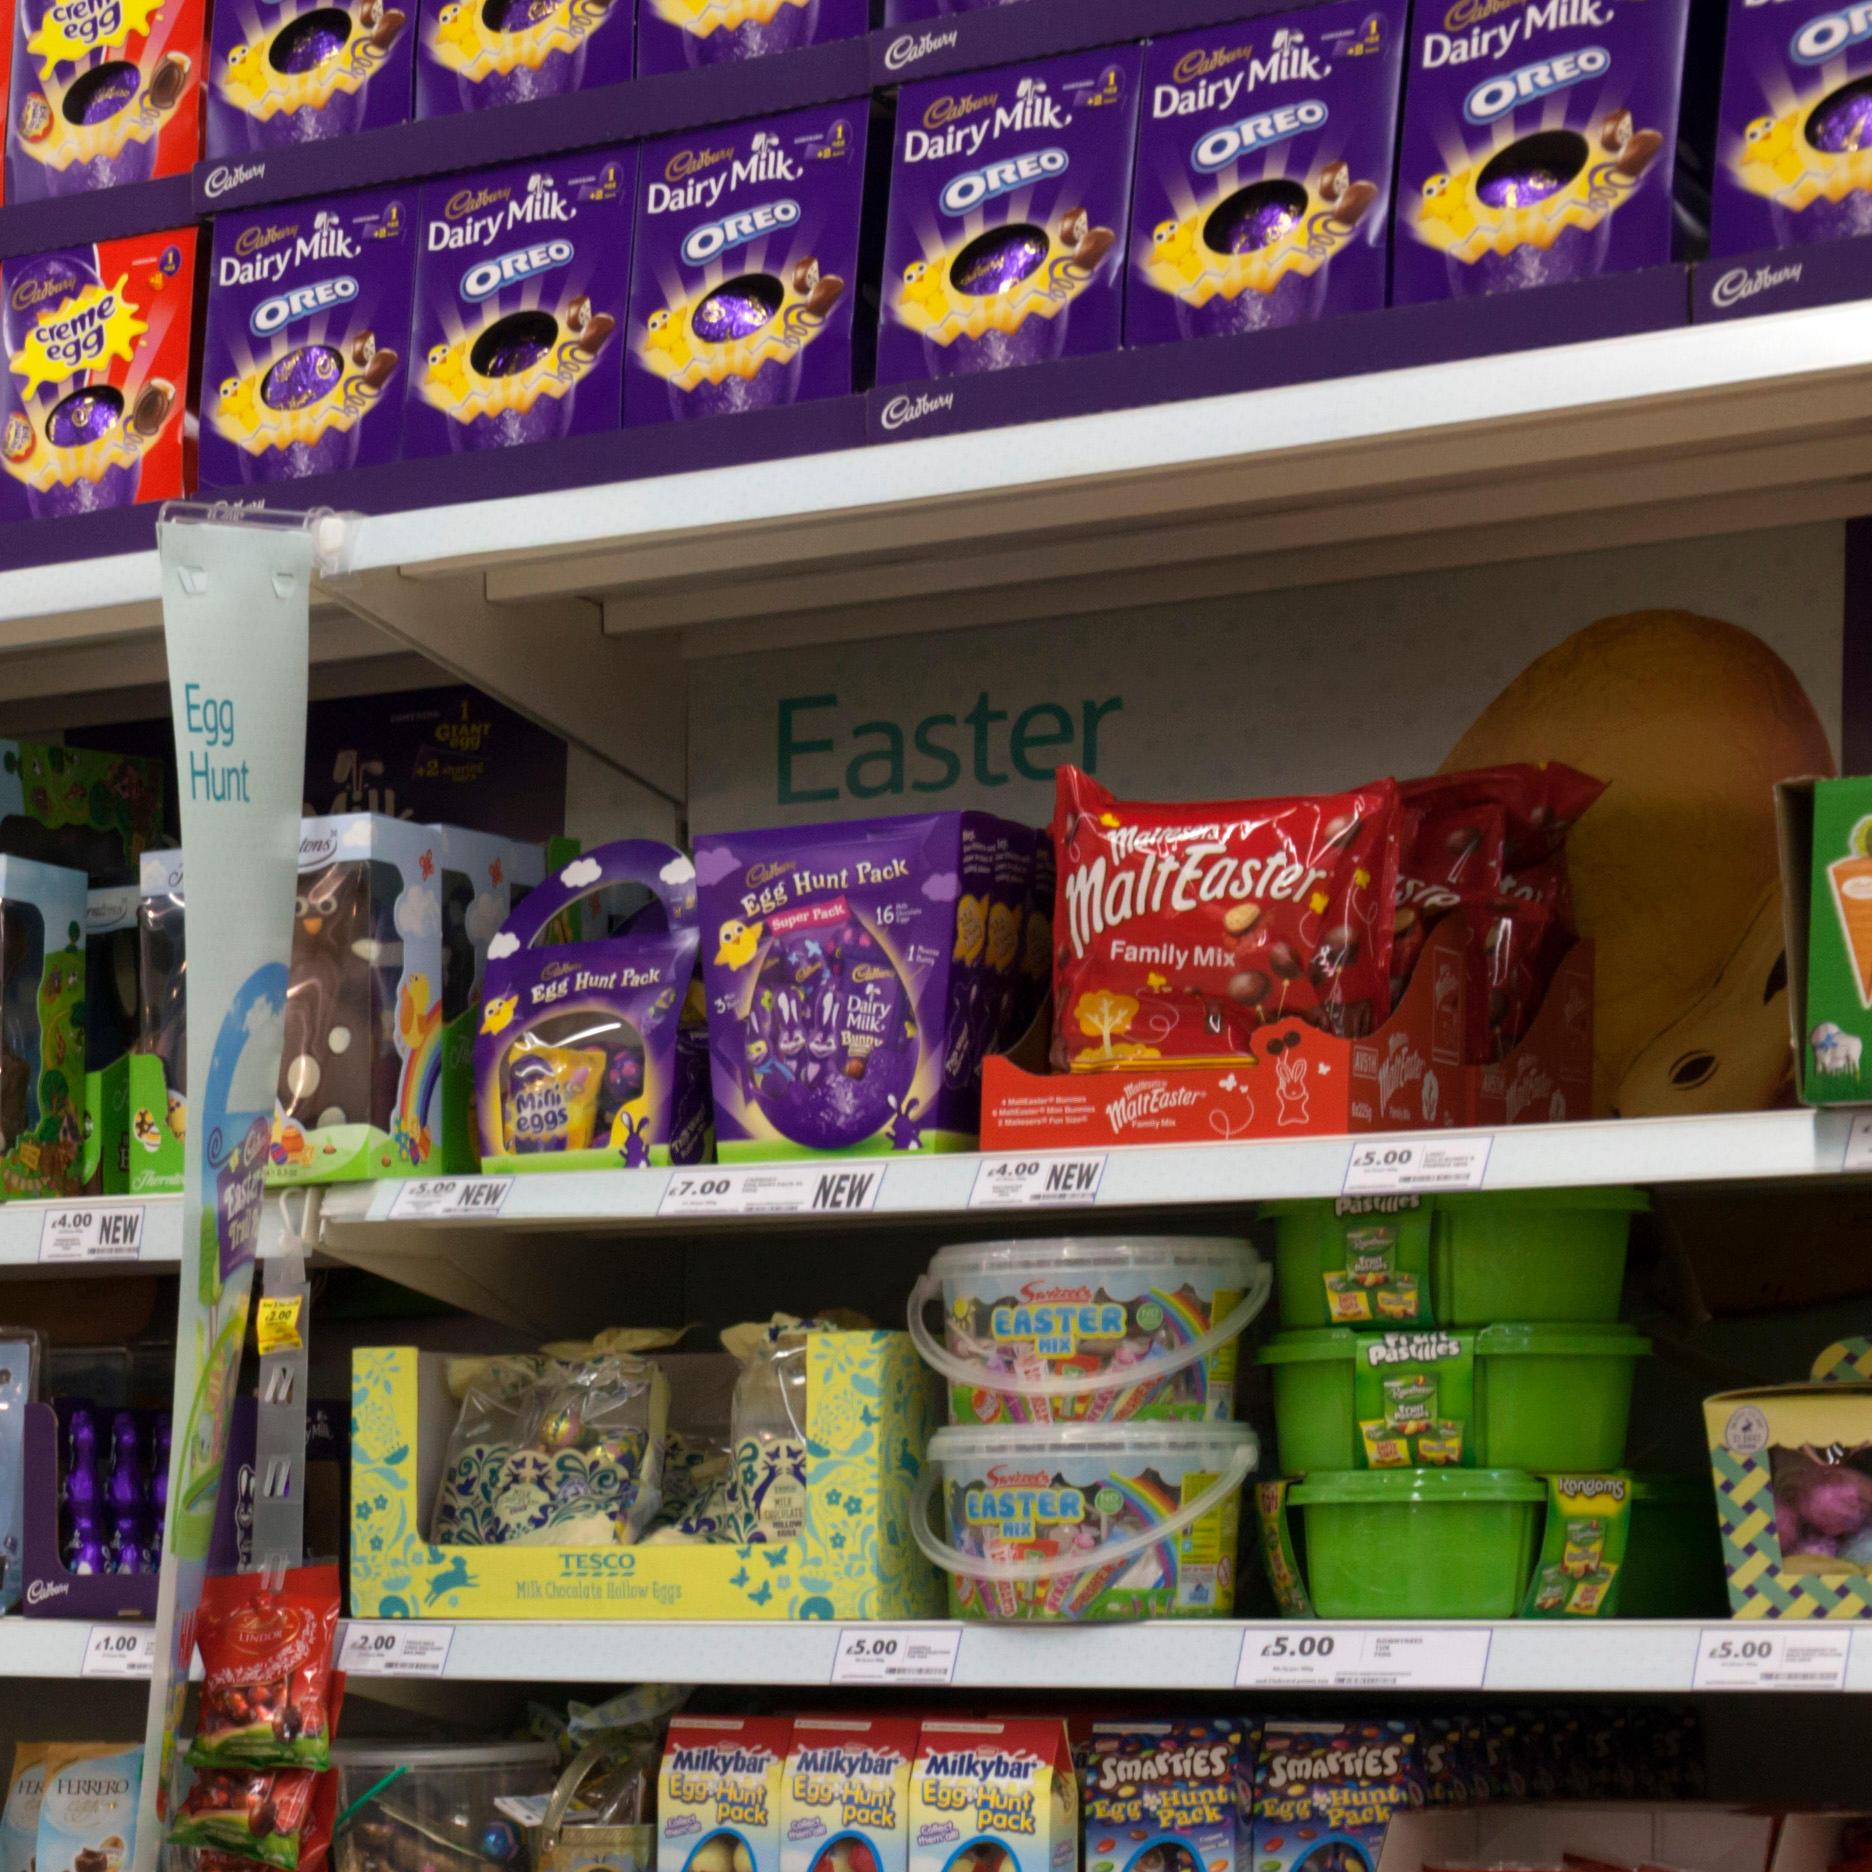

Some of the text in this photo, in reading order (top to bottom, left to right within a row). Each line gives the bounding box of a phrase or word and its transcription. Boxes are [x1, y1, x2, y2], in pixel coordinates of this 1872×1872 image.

[1153, 52, 1332, 118] Dairy Milk
[1194, 101, 1328, 167] OREO
[204, 160, 266, 198] Cadbury
[647, 149, 803, 215] Dairy Milk
[685, 201, 800, 263] OREO
[35, 296, 118, 348] creme
[46, 322, 108, 366] egg
[881, 391, 955, 430] Cadbury
[184, 682, 235, 748] Egg
[775, 688, 1122, 801] Easter
[188, 750, 251, 805] Hunt
[741, 858, 909, 918] Egg Hunt Pack
[1065, 838, 1328, 960] MaltEaster
[771, 901, 847, 933] Super Pack
[1109, 937, 1236, 970] Family Mix
[531, 967, 660, 1005] Egg Hunt Pack
[846, 995, 891, 1020] Dairy
[515, 1086, 563, 1116] Mini
[1105, 1085, 1202, 1135] MaltEaster
[515, 1105, 569, 1134] eggs
[669, 1178, 732, 1198] £7.00
[814, 1174, 873, 1210] NEW
[51, 1212, 139, 1247] £4.00 NEW
[1368, 1338, 1462, 1366] Pastilles
[966, 1490, 1084, 1522] EASTER
[1003, 1520, 1033, 1539] MIX
[558, 1552, 636, 1571] TESCO
[515, 1580, 682, 1605] Milk Chocolate Hollow Eggs
[1261, 1634, 1335, 1659] £5.00
[925, 1752, 1040, 1782] Milkybar
[56, 1776, 131, 1796] FERRERO
[922, 1781, 1032, 1812] Egg Hunt
[977, 1809, 1036, 1832] pack
[1094, 1788, 1228, 1824] Egg Hunt
[1158, 1805, 1222, 1829] Pack
